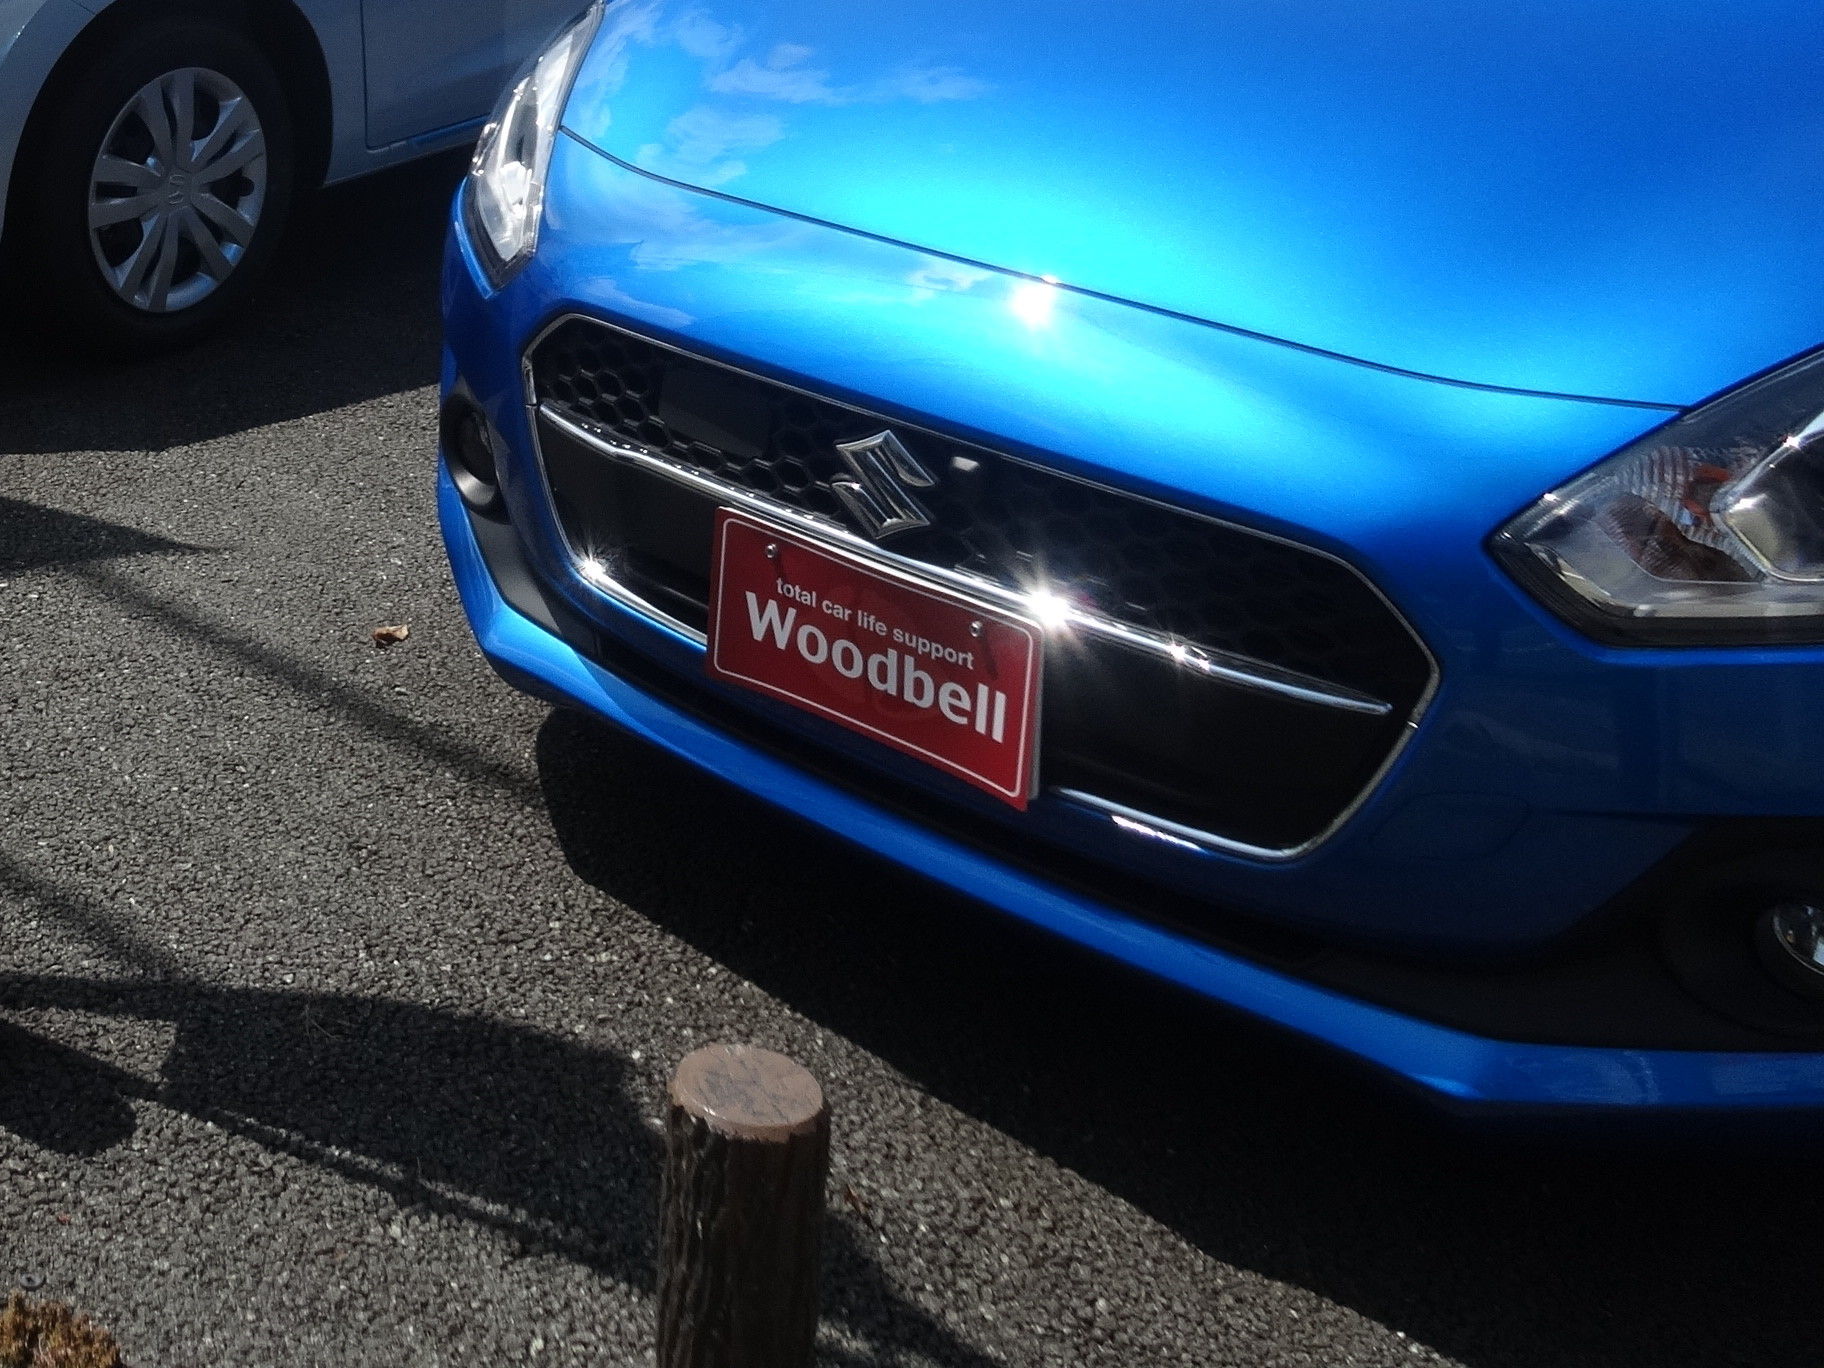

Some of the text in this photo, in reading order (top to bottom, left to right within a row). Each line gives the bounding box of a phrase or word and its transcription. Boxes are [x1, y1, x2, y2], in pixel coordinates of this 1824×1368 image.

[744, 590, 1007, 744] Woodbell
[775, 576, 975, 670] total car life support
